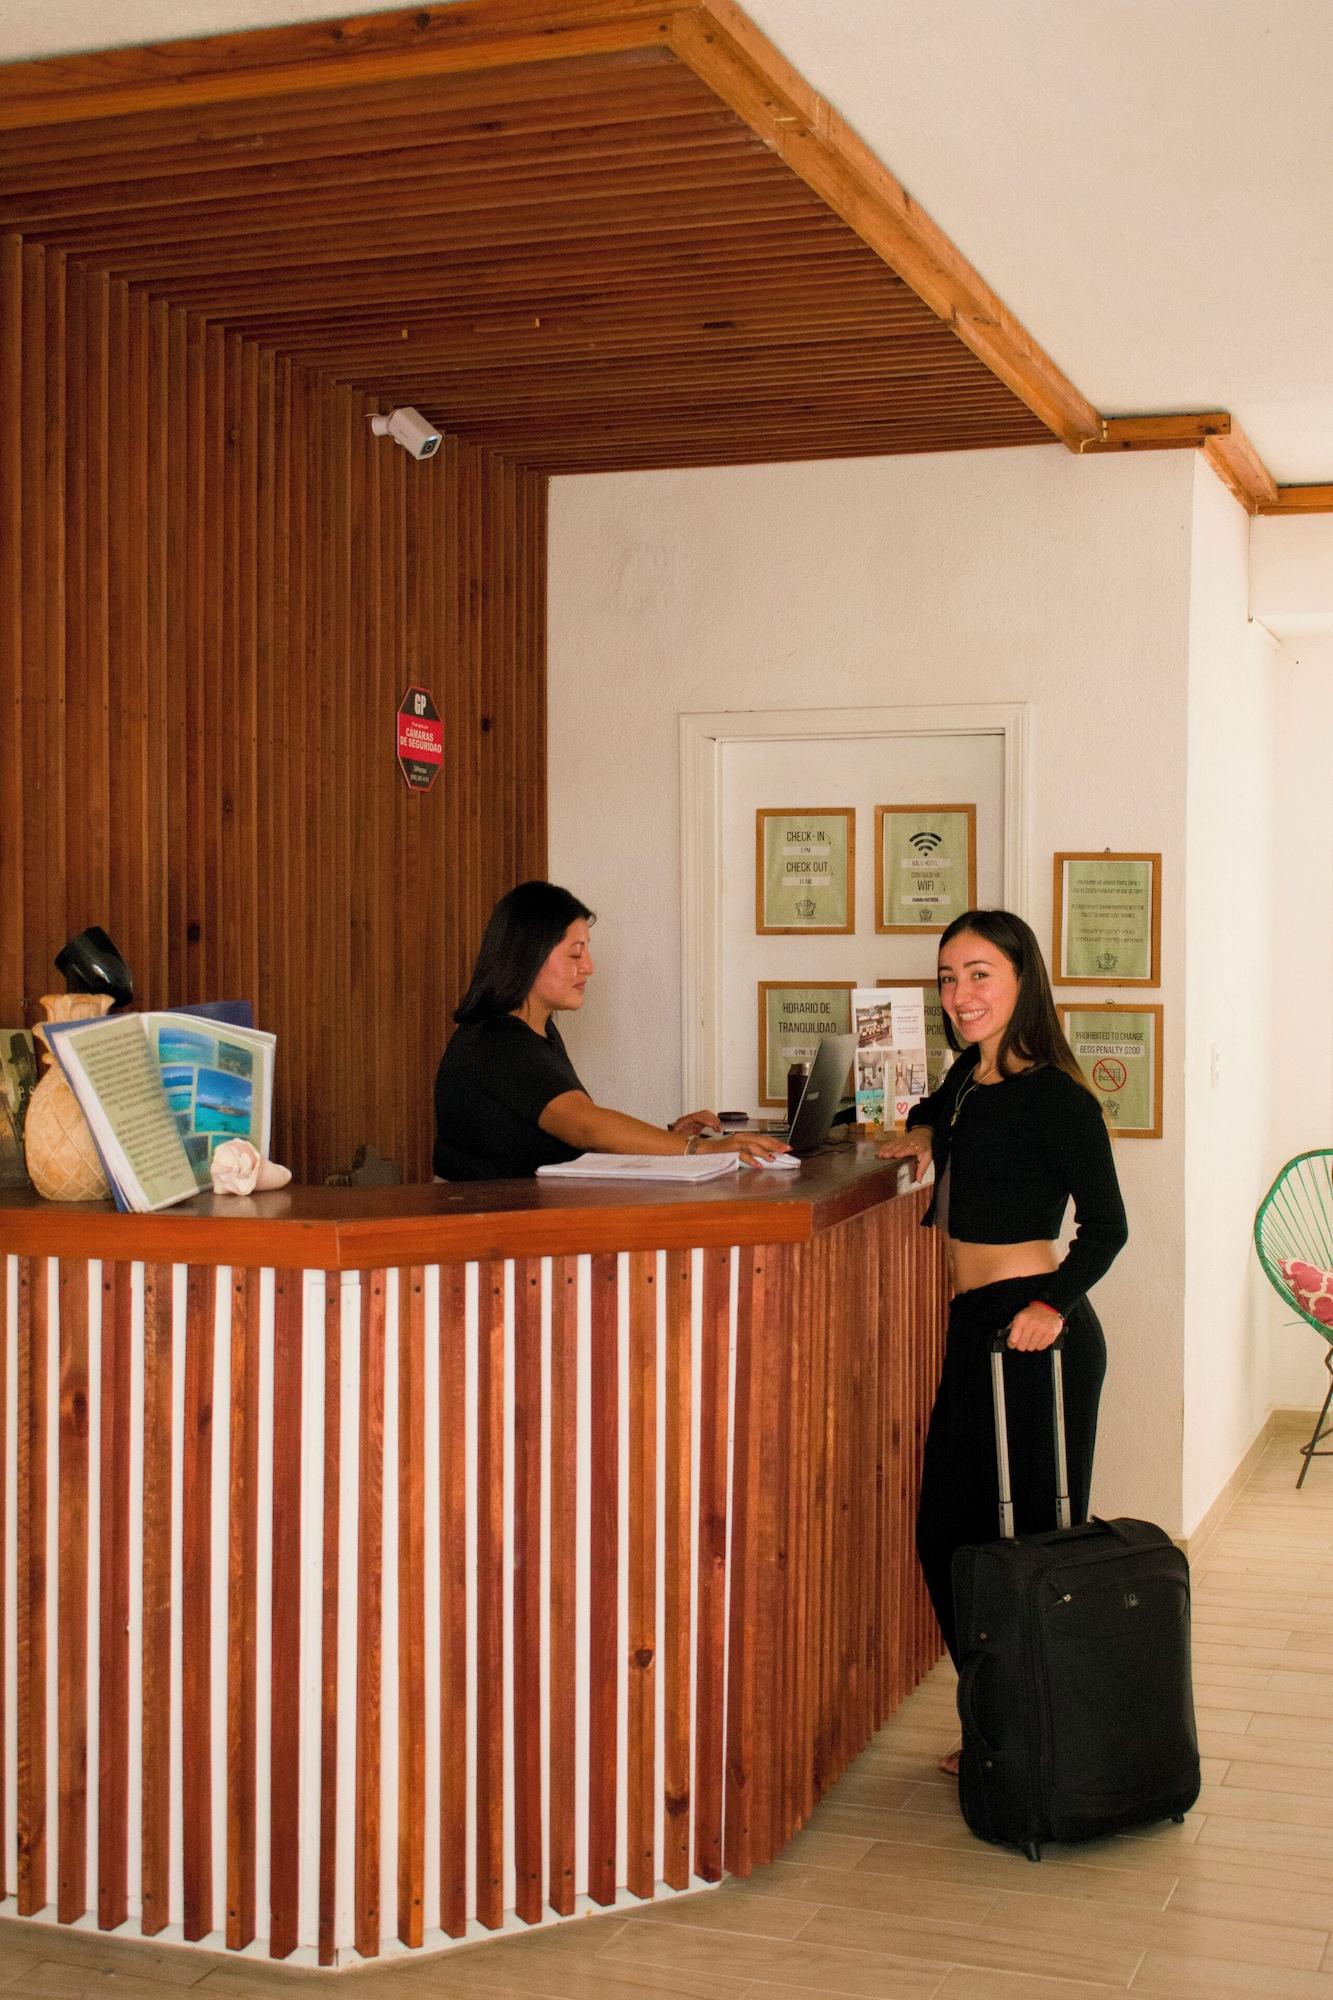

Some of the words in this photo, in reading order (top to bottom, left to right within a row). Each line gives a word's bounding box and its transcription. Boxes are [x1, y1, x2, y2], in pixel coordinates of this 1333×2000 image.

[415, 693, 427, 716] GP
[400, 736, 408, 746] DE
[408, 738, 442, 753] SEGURIDAD
[817, 831, 825, 841] IN
[786, 862, 811, 873] CHECK
[813, 862, 828, 872] OUT
[917, 880, 934, 891] WIFI
[783, 1002, 819, 1014] HORARIO
[820, 1002, 831, 1014] DE
[778, 1021, 837, 1033] TRANQUILIDAD
[1076, 1031, 1110, 1041] PROHIBITED
[1111, 1031, 1120, 1041] TO
[1120, 1032, 1144, 1041] CHANGE
